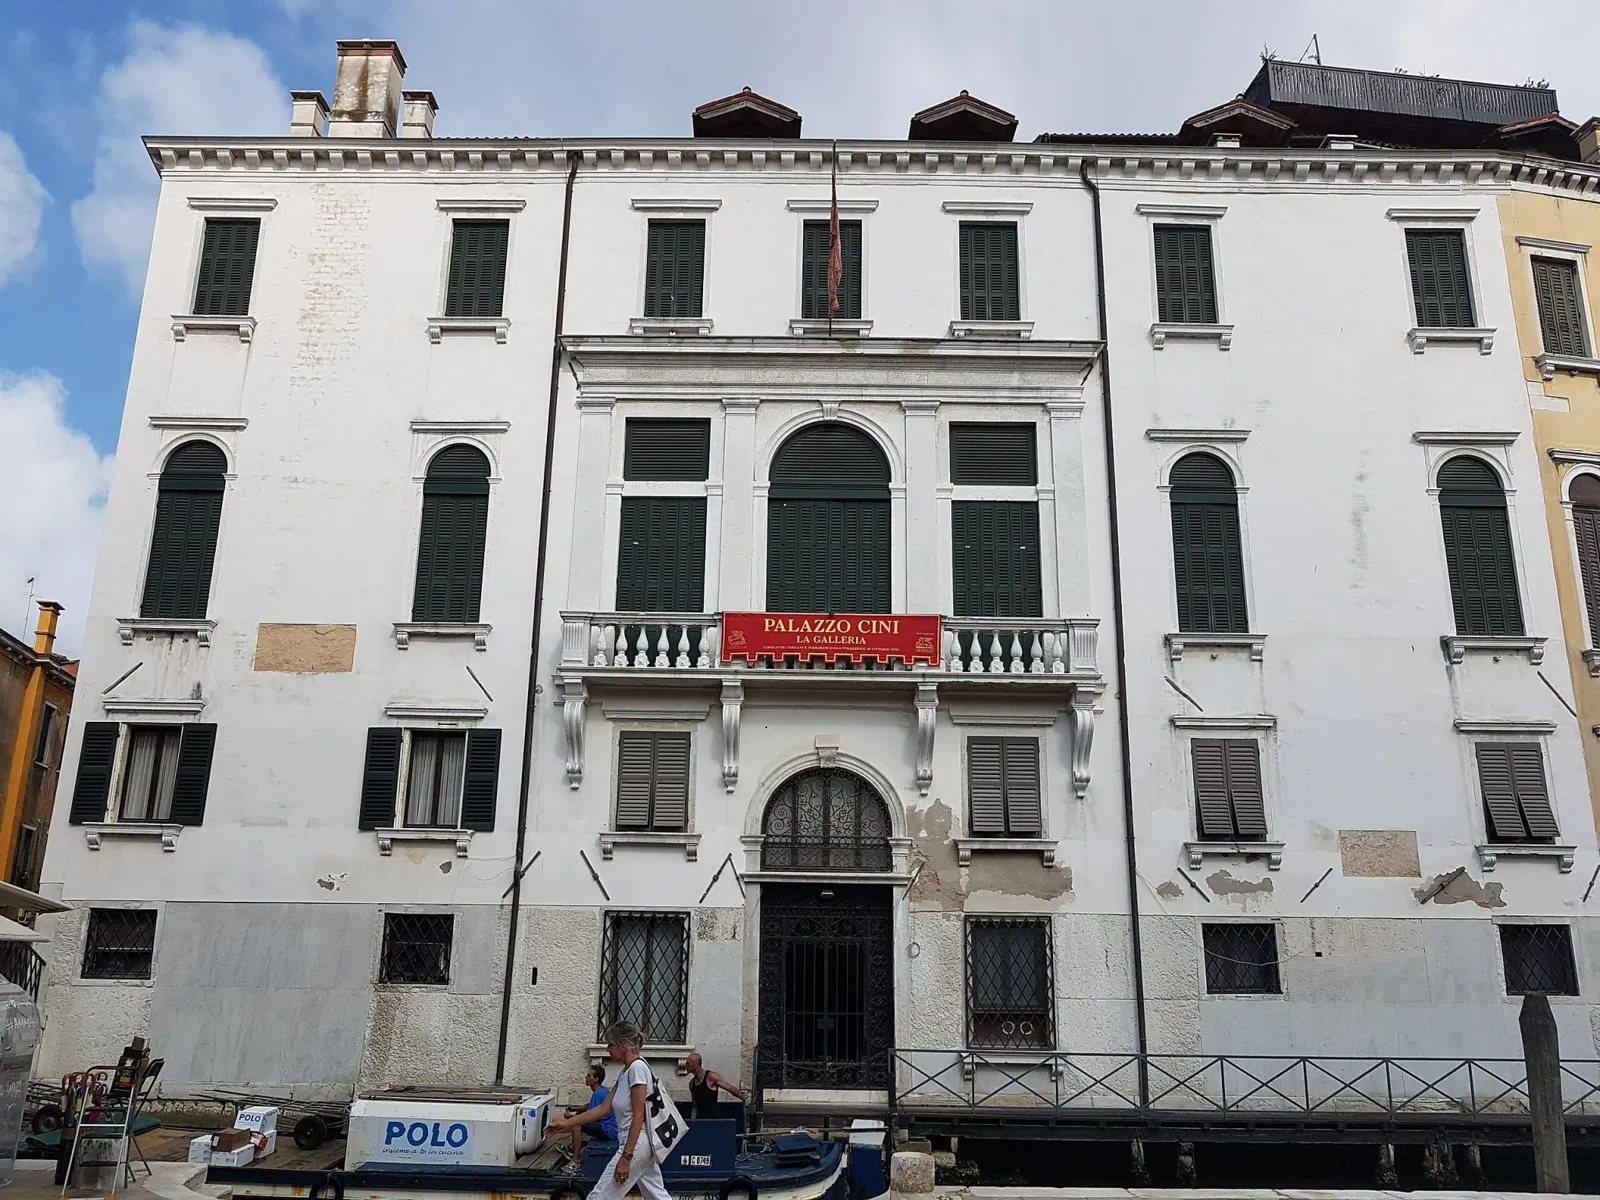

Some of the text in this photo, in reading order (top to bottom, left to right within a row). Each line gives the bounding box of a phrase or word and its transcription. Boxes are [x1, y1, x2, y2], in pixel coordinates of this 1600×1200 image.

[764, 618, 900, 634] PALAZZO CINI
[796, 635, 867, 645] LA GALLERIA
[238, 1113, 261, 1123] POLO
[384, 1121, 469, 1148] POLO
